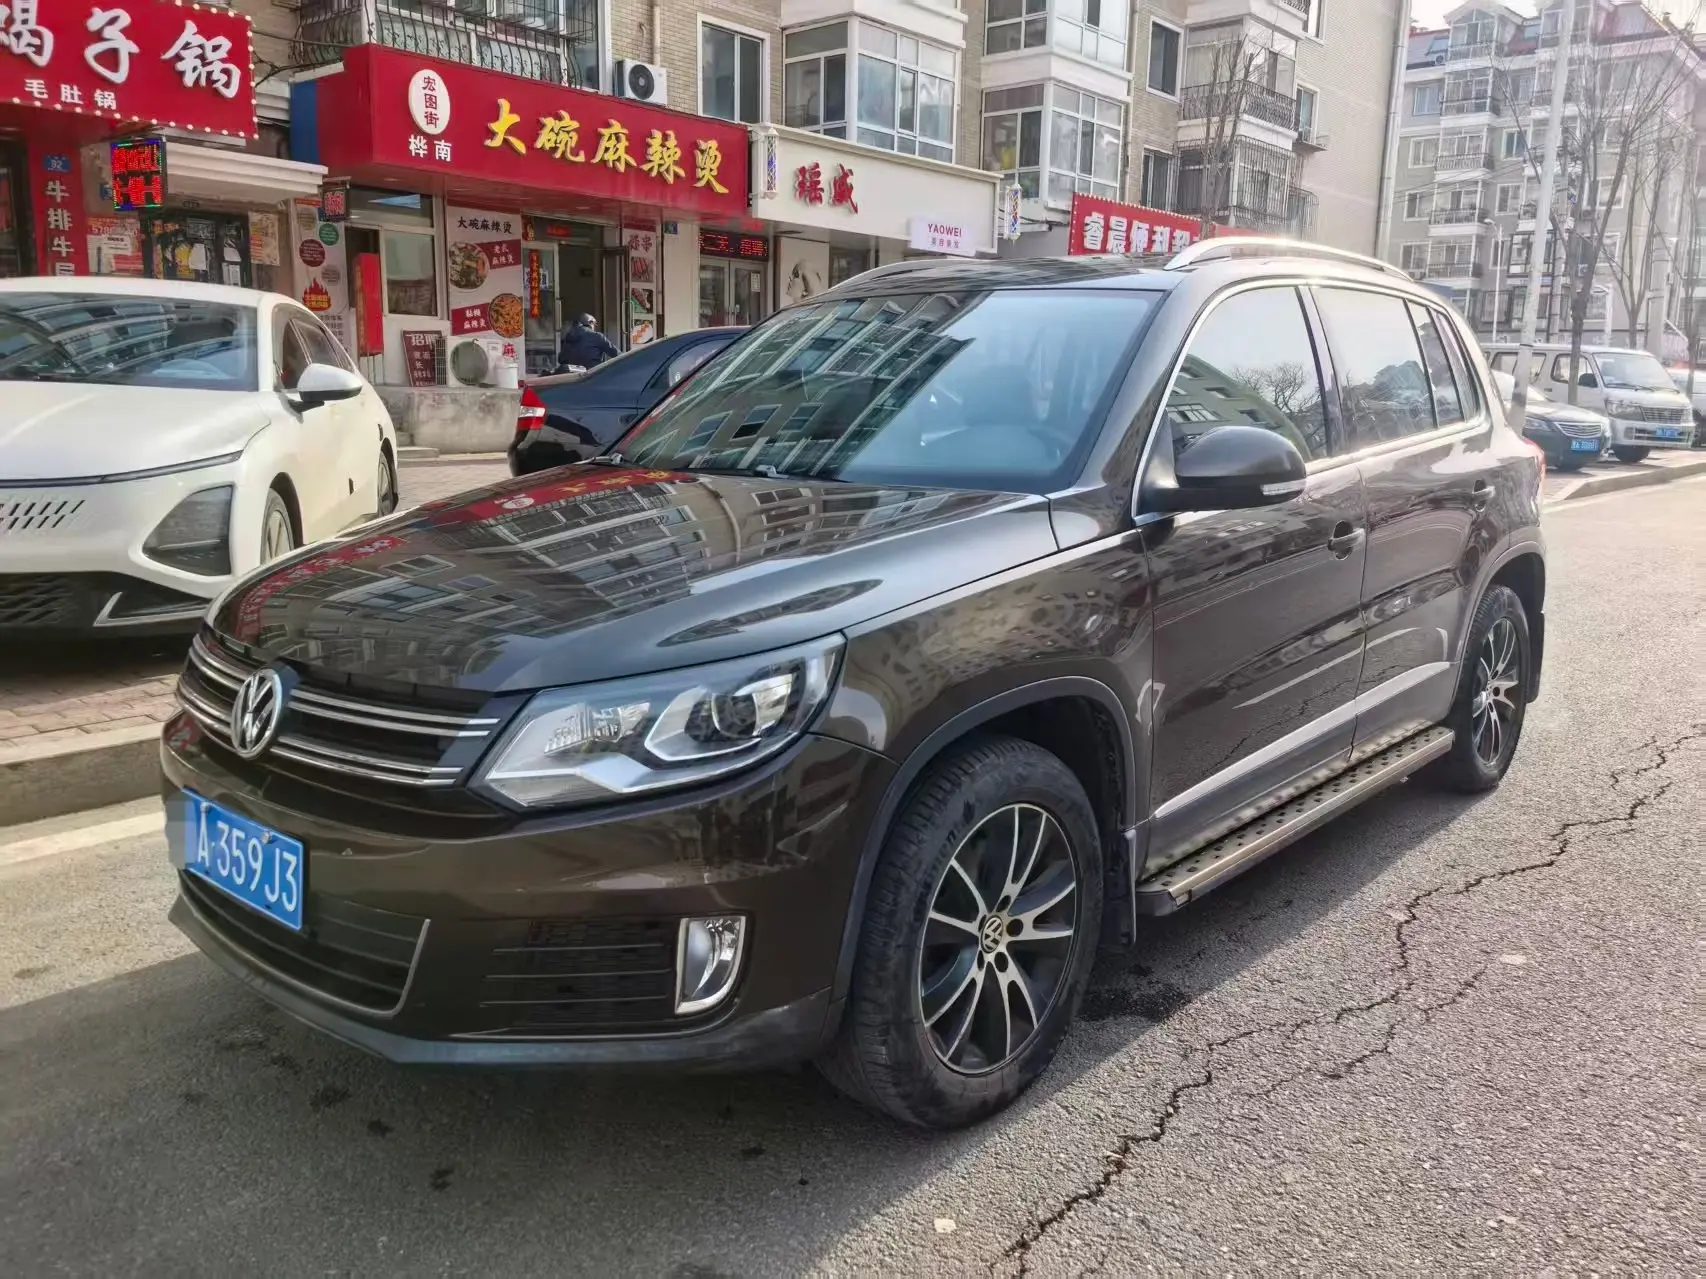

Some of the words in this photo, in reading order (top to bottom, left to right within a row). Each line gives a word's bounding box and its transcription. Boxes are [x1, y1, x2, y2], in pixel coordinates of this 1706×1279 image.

[24, 78, 117, 110] 毛肚锅
[422, 76, 439, 128] 宏图街
[408, 134, 452, 161] 桦南
[484, 98, 729, 194] 大碗麻辣烫
[457, 216, 513, 235] 大碗麻辣烫
[927, 223, 962, 237] YAOWEI
